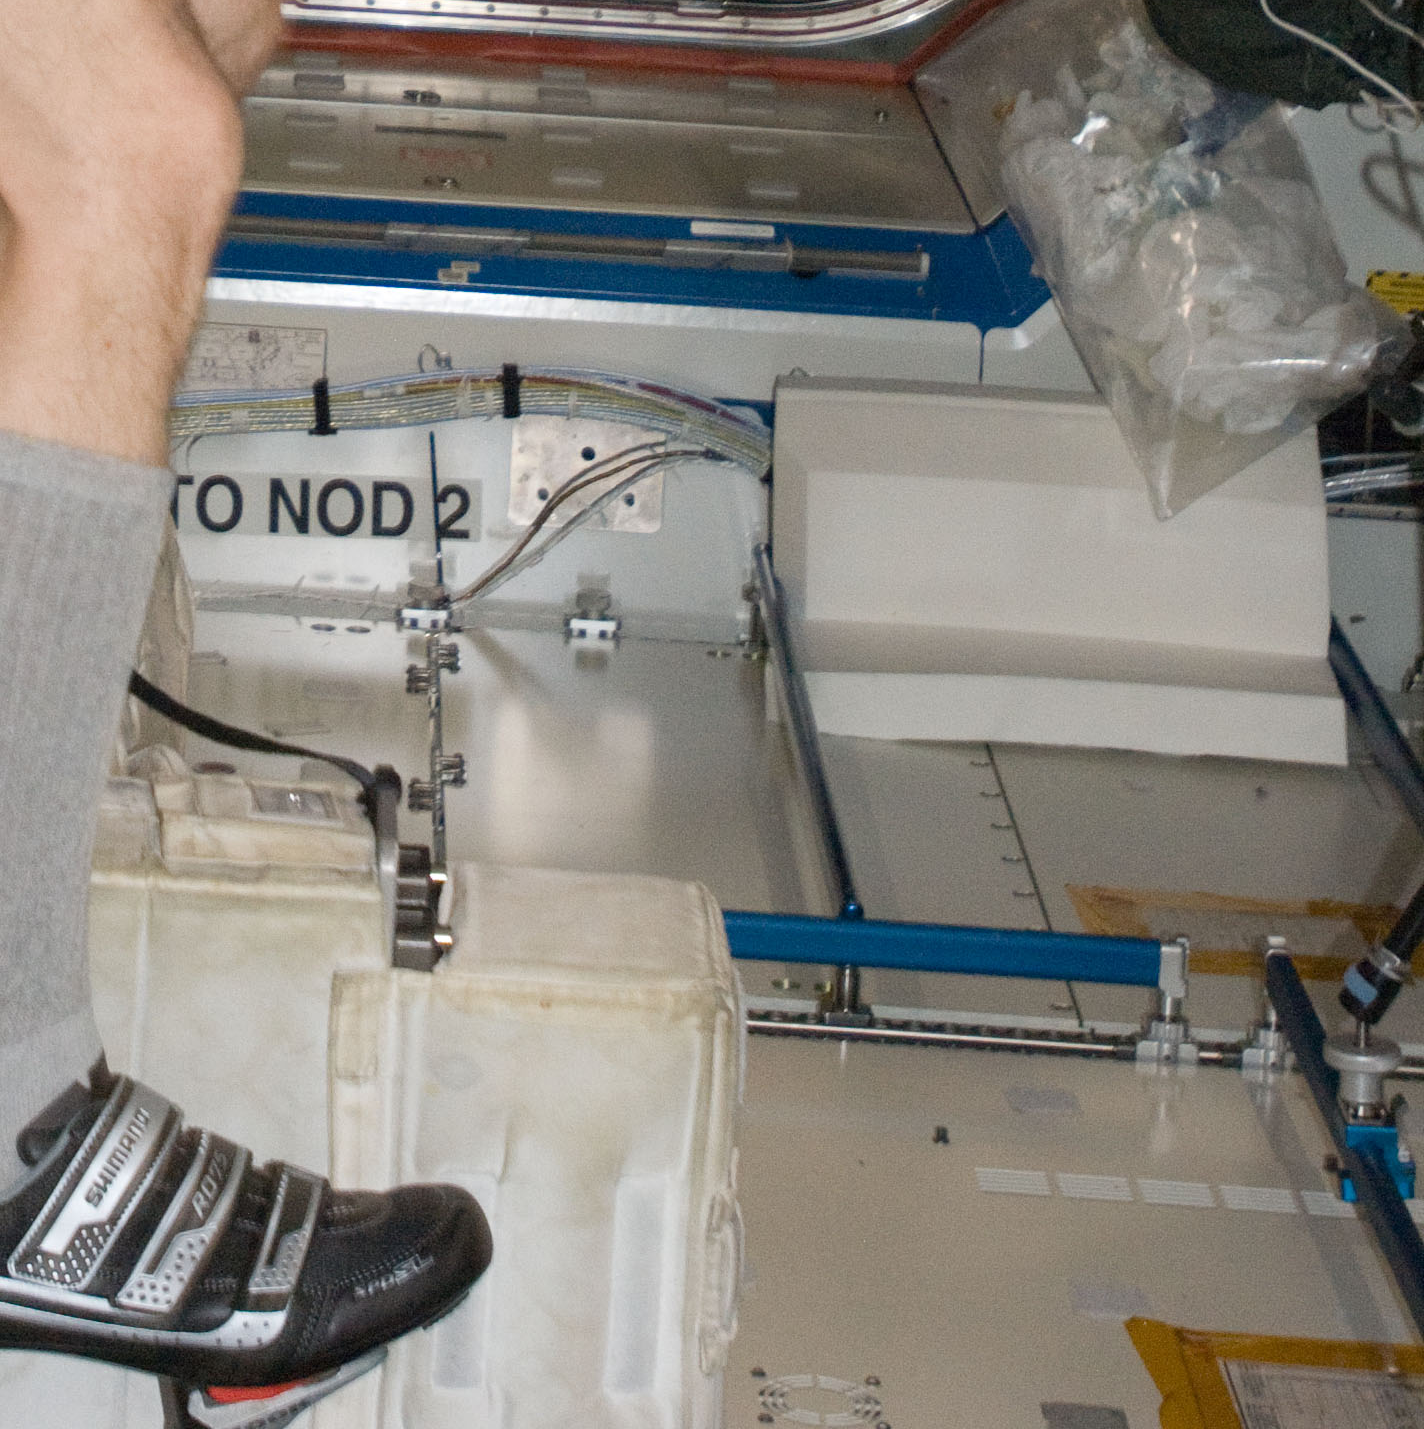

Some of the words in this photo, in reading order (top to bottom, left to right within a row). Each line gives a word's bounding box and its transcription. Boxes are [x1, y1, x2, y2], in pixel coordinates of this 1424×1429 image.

[168, 472, 245, 535] TO
[266, 472, 415, 541] NOD
[435, 482, 472, 540] 2
[81, 1105, 153, 1208] SHIMANO
